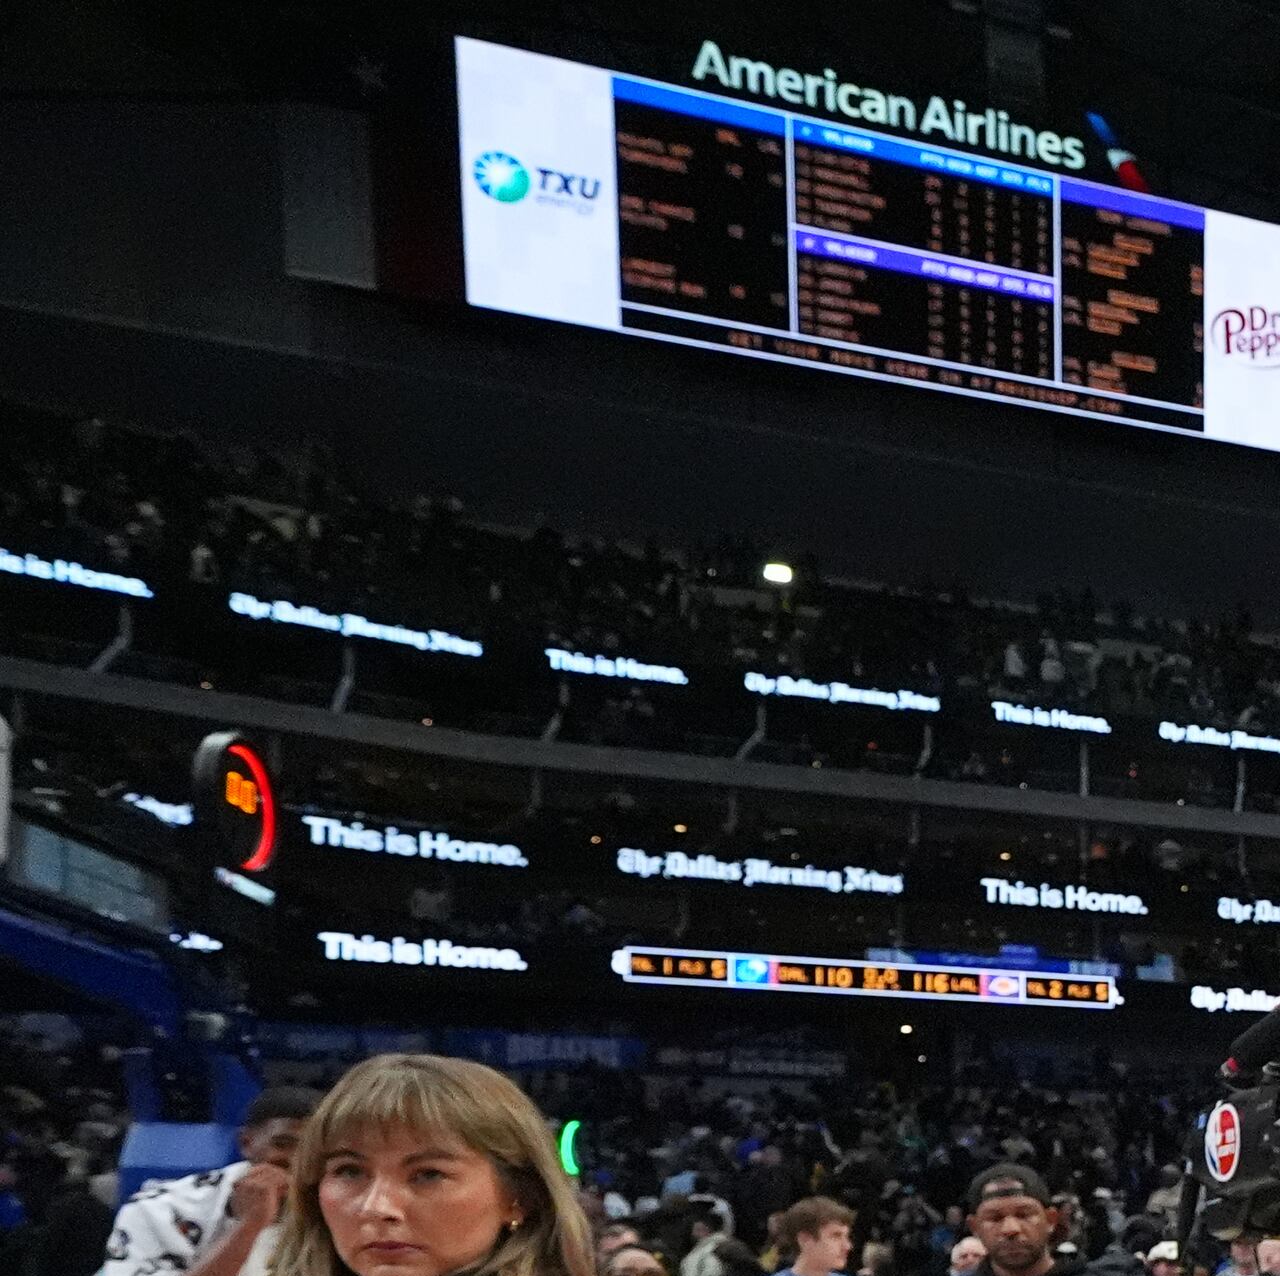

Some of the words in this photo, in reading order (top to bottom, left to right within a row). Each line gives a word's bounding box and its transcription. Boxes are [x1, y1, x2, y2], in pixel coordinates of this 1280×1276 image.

[692, 40, 917, 131] American
[919, 96, 1086, 169] Airlines
[536, 168, 600, 200] TXU
[616, 657, 688, 684] Home.
[1050, 709, 1111, 733] Home.
[302, 816, 384, 852] This
[384, 827, 418, 856] is
[419, 831, 528, 867] Home.
[662, 852, 742, 880] Dallas
[980, 878, 1039, 906] This
[1040, 883, 1064, 908] is
[1065, 885, 1148, 914] Home.
[317, 932, 392, 963] This
[392, 937, 422, 964] is
[422, 939, 528, 970] Home.
[913, 972, 950, 994] 116
